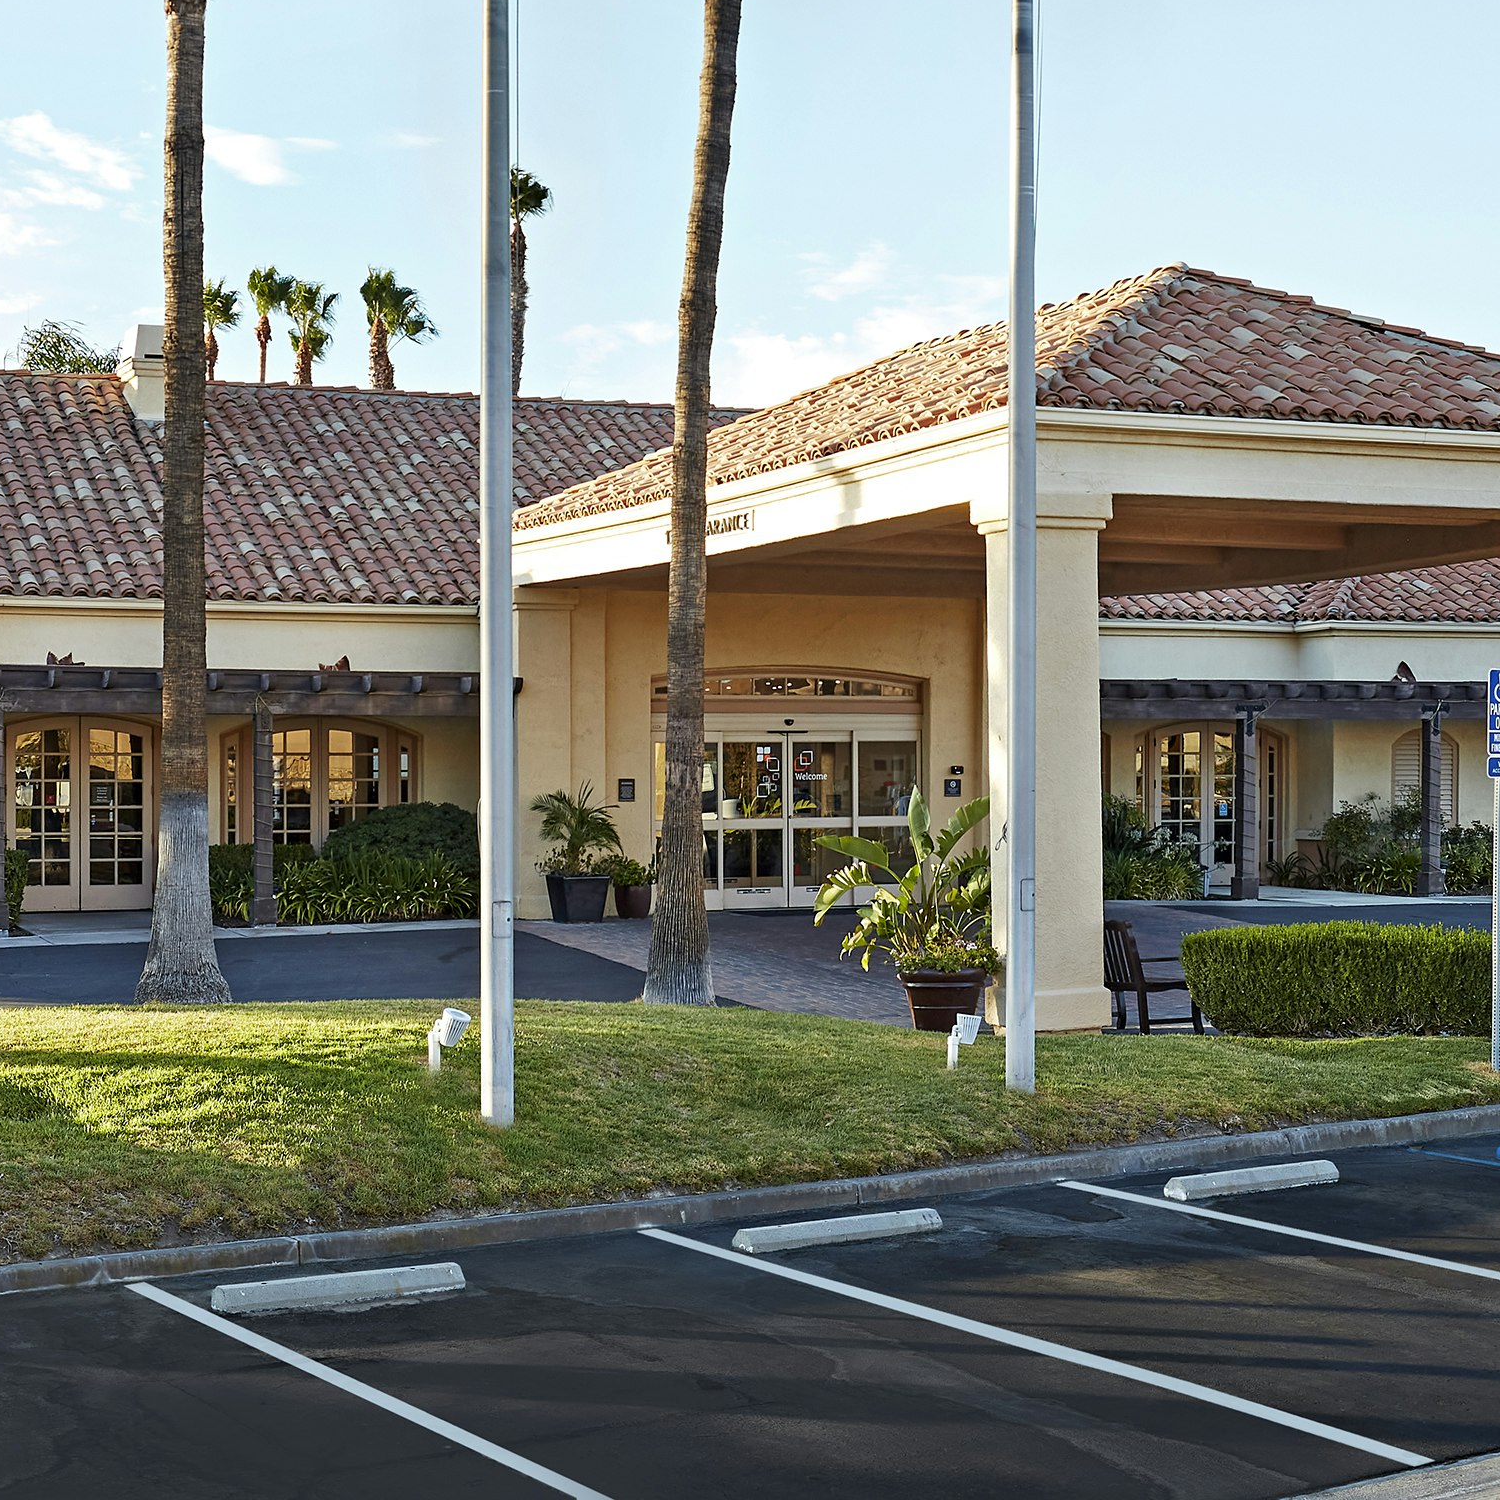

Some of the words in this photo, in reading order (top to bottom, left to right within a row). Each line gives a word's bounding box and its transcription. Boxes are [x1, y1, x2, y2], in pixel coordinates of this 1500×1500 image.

[706, 513, 749, 536] ARANCE
[1491, 744, 1500, 752] FINE
[795, 772, 827, 780] Welcome
